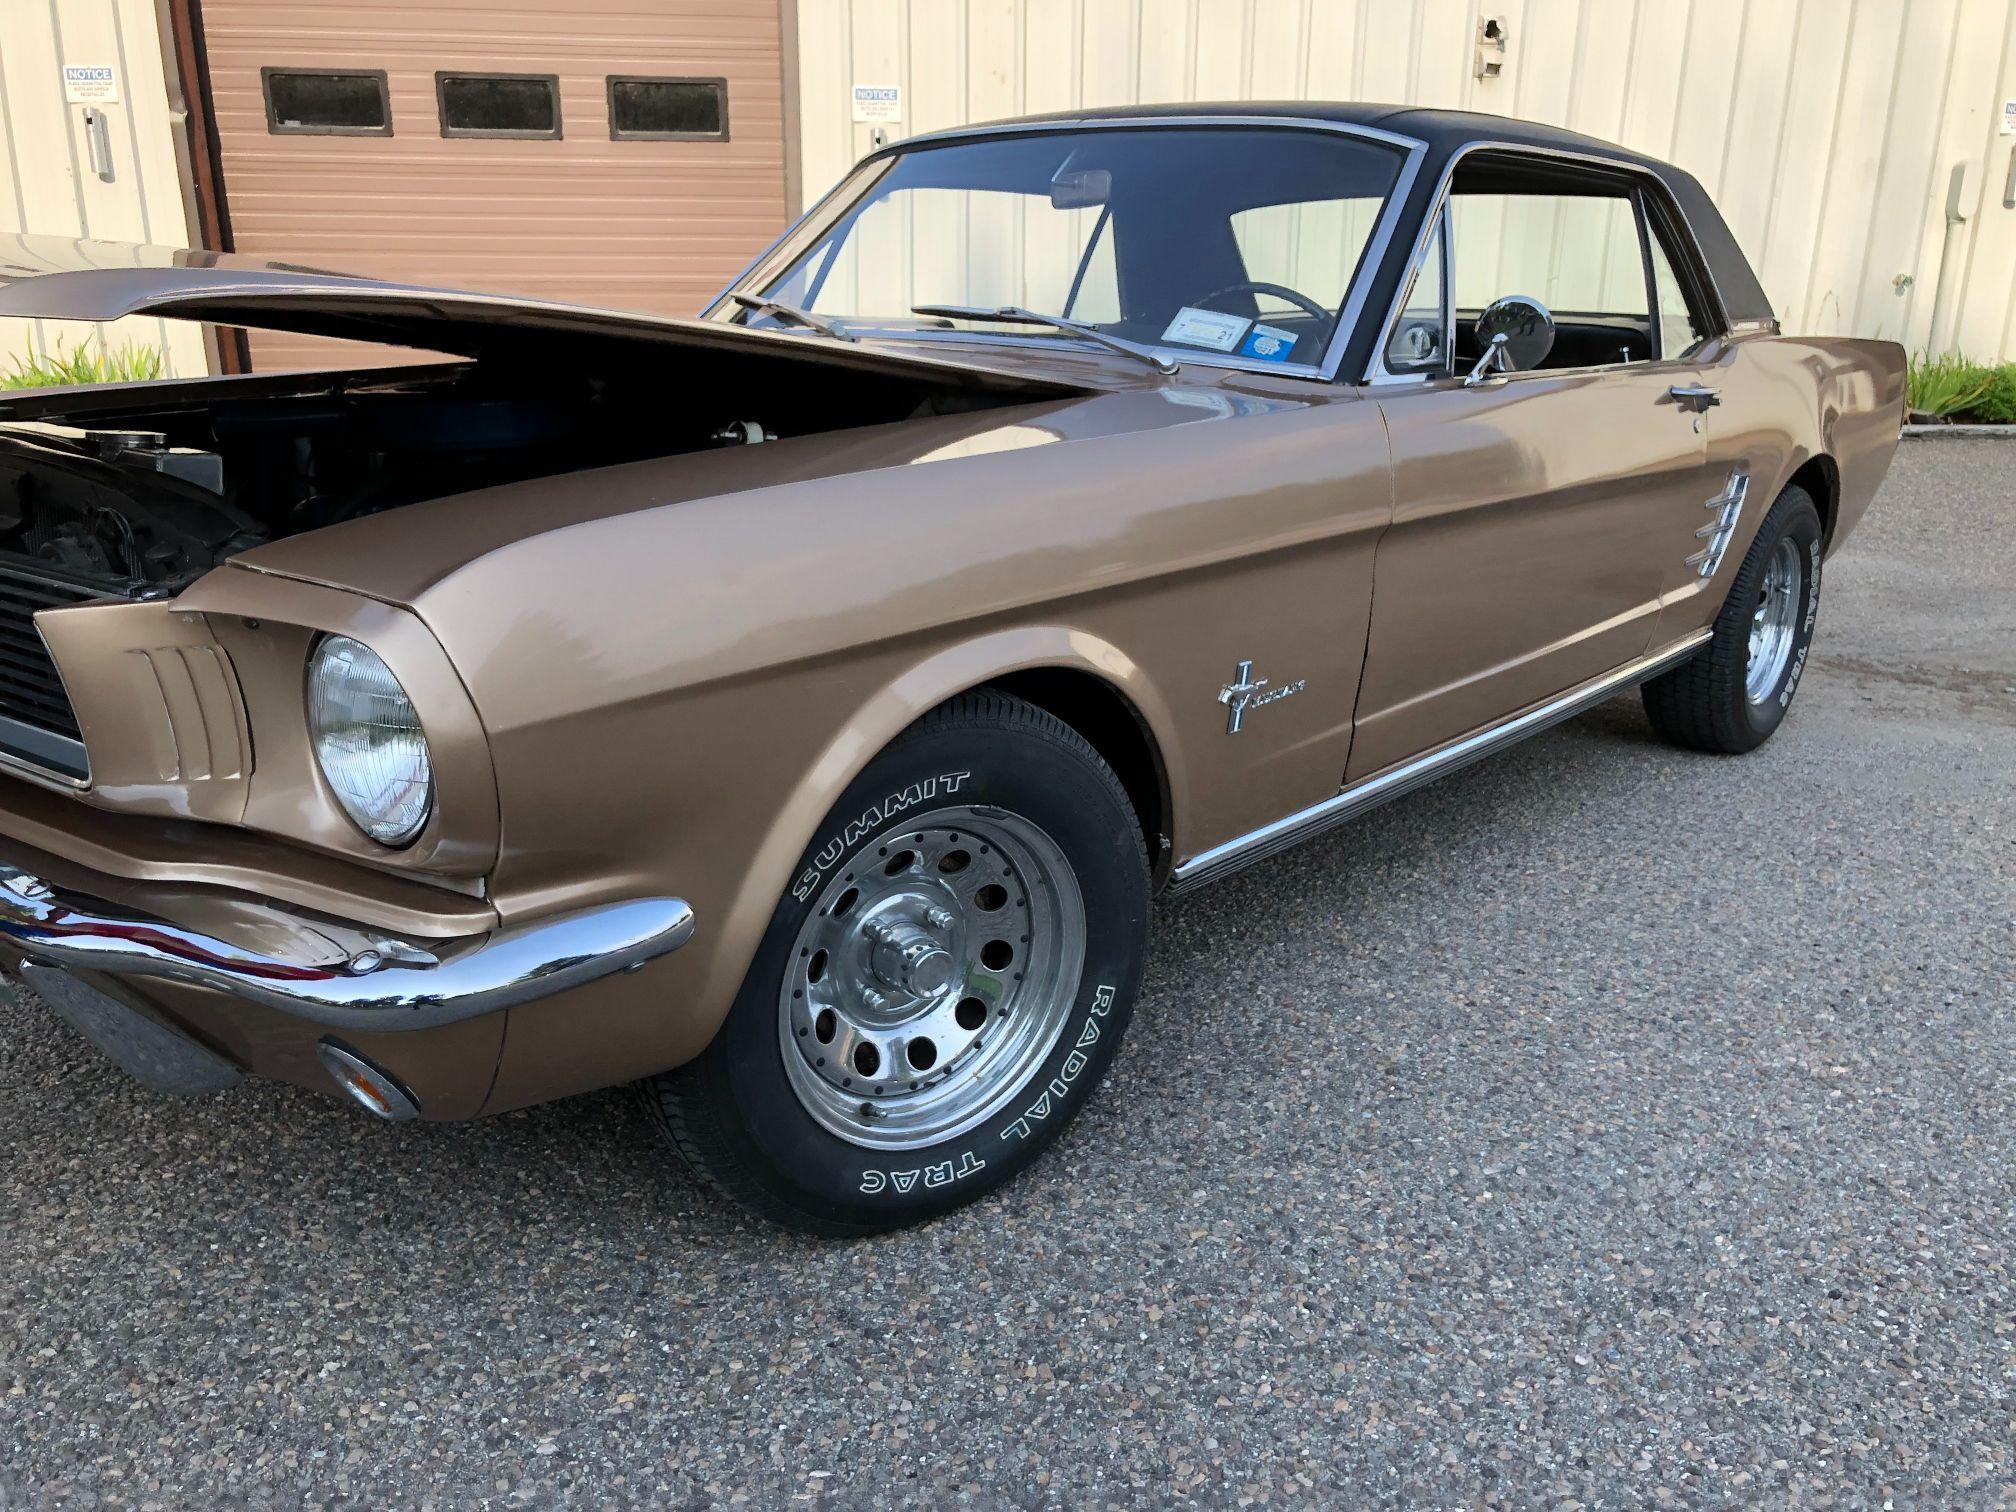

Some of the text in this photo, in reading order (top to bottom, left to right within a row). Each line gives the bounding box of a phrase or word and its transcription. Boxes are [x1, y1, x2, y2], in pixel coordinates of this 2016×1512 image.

[68, 69, 111, 79] NOTICE
[857, 90, 897, 99] NOTICE
[1217, 329, 1234, 341] 21
[790, 770, 972, 902] SUMMIT
[858, 984, 1116, 1195] RADIAL TRAC
